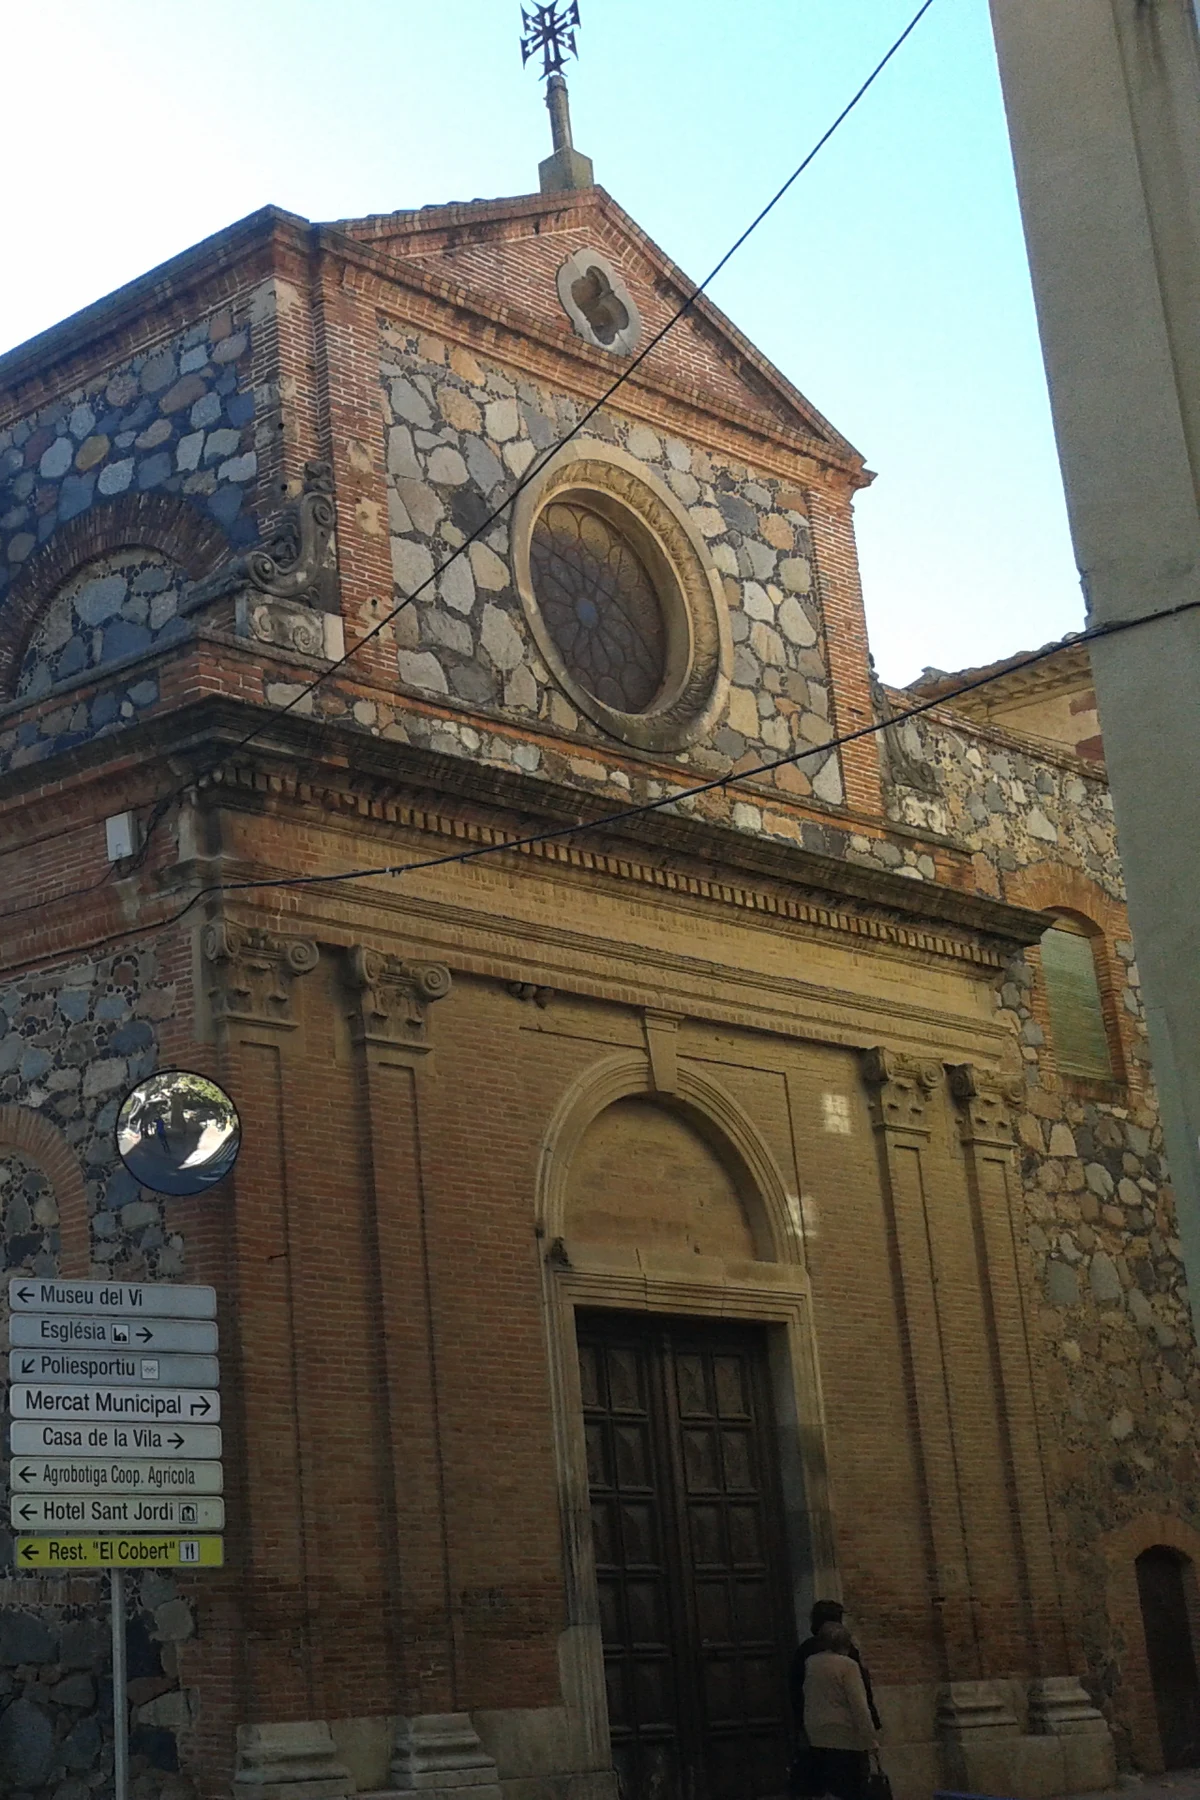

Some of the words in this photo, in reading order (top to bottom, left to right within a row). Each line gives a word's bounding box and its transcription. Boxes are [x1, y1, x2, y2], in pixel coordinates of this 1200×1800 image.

[41, 1285, 94, 1305] Museu
[100, 1286, 123, 1305] del
[128, 1289, 142, 1306] Vi
[41, 1321, 105, 1341] Església
[42, 1356, 135, 1379] Poliesportiu
[26, 1390, 89, 1411] Mercat
[96, 1393, 181, 1417] Municipal
[43, 1428, 82, 1446] Casa
[88, 1429, 108, 1446] de
[114, 1430, 128, 1447] la
[133, 1430, 161, 1447] Vila
[43, 1465, 107, 1485] Agrobotiga
[111, 1467, 144, 1484] Coop.
[148, 1467, 195, 1487] Agrícola
[44, 1502, 85, 1520] Hotel
[91, 1503, 128, 1520] Sant
[134, 1503, 173, 1520] Jordi
[49, 1543, 87, 1560] Rest.
[93, 1542, 113, 1559] "El
[118, 1543, 175, 1560] Cobert"
